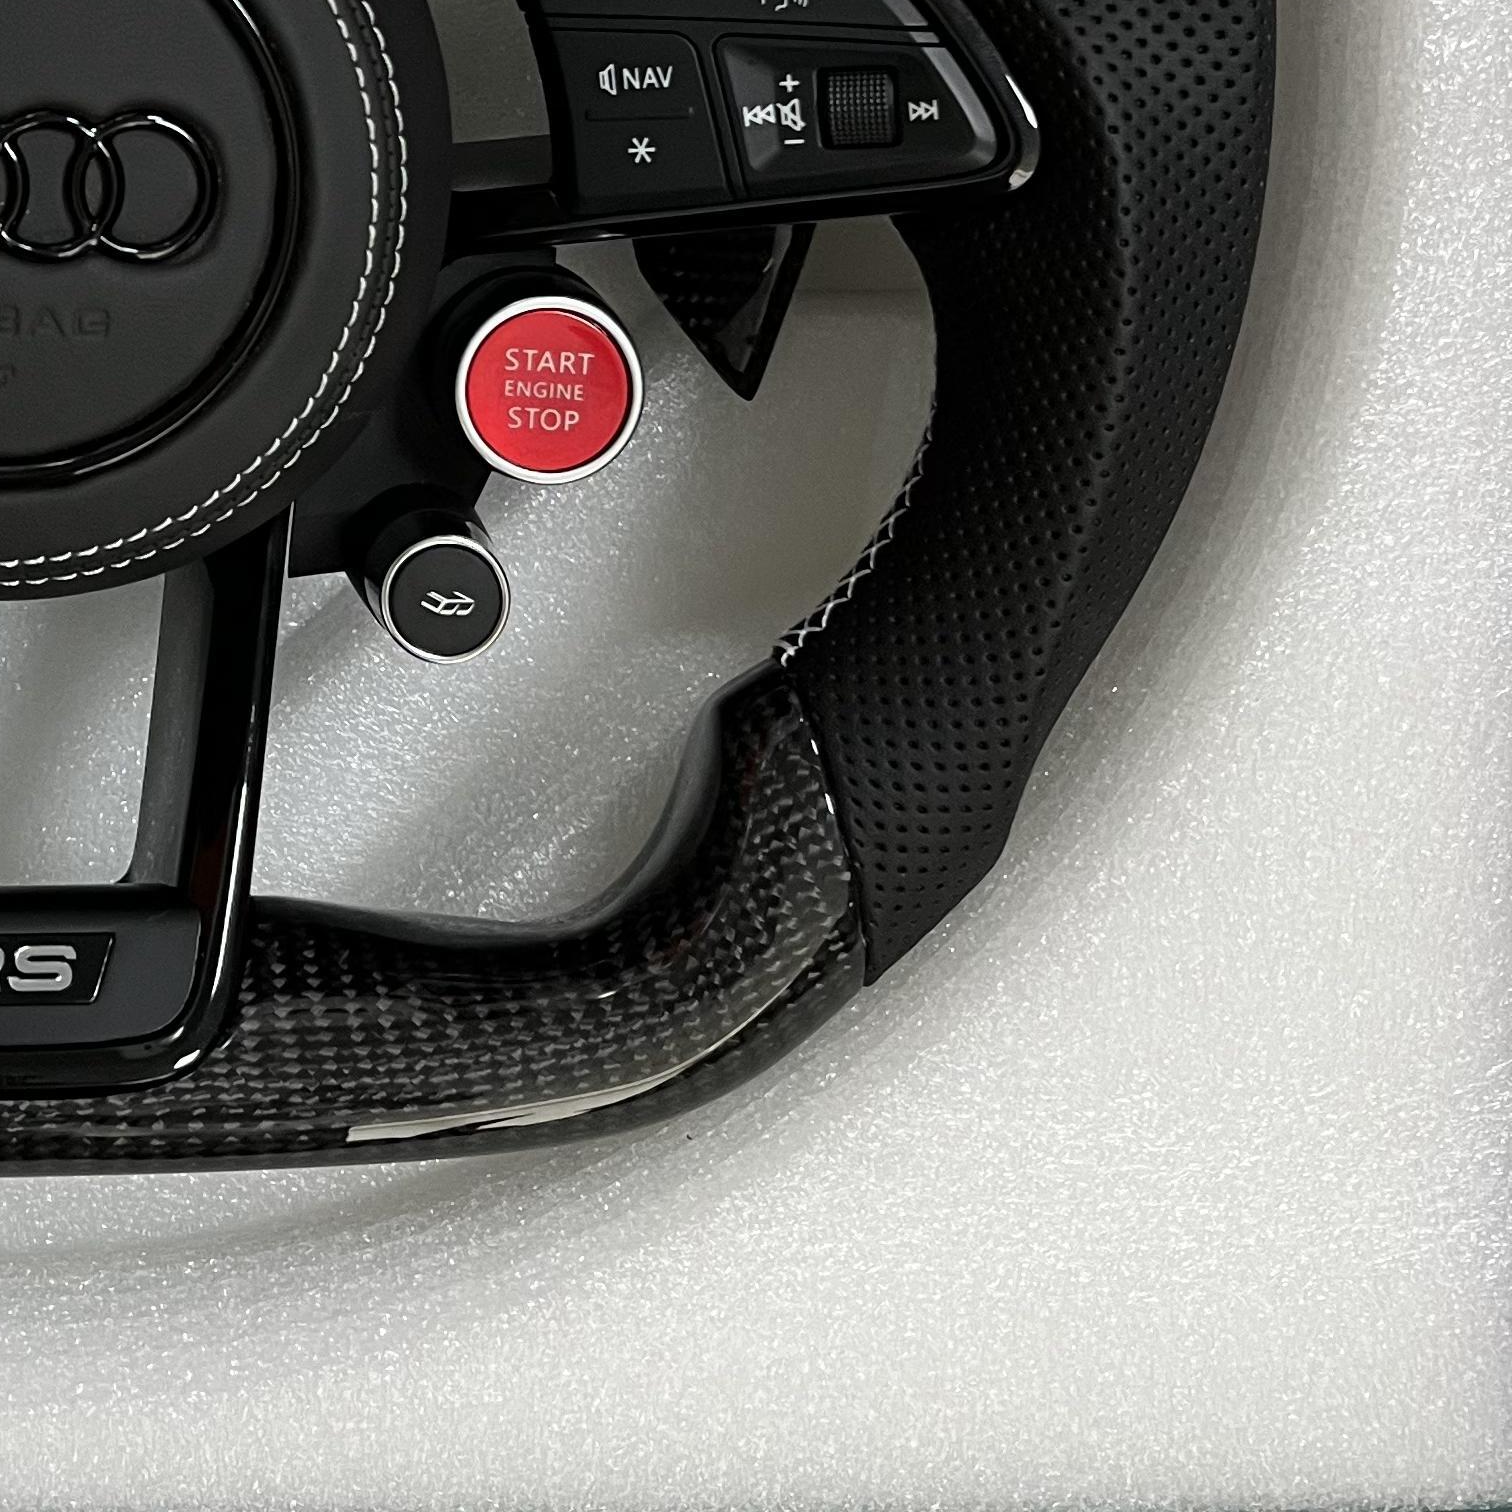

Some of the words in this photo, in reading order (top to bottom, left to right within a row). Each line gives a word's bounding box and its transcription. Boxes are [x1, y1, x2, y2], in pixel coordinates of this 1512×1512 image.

[622, 66, 674, 89] NAV
[504, 348, 595, 375] START
[504, 379, 585, 401] ENGINE
[507, 406, 580, 431] STOP
